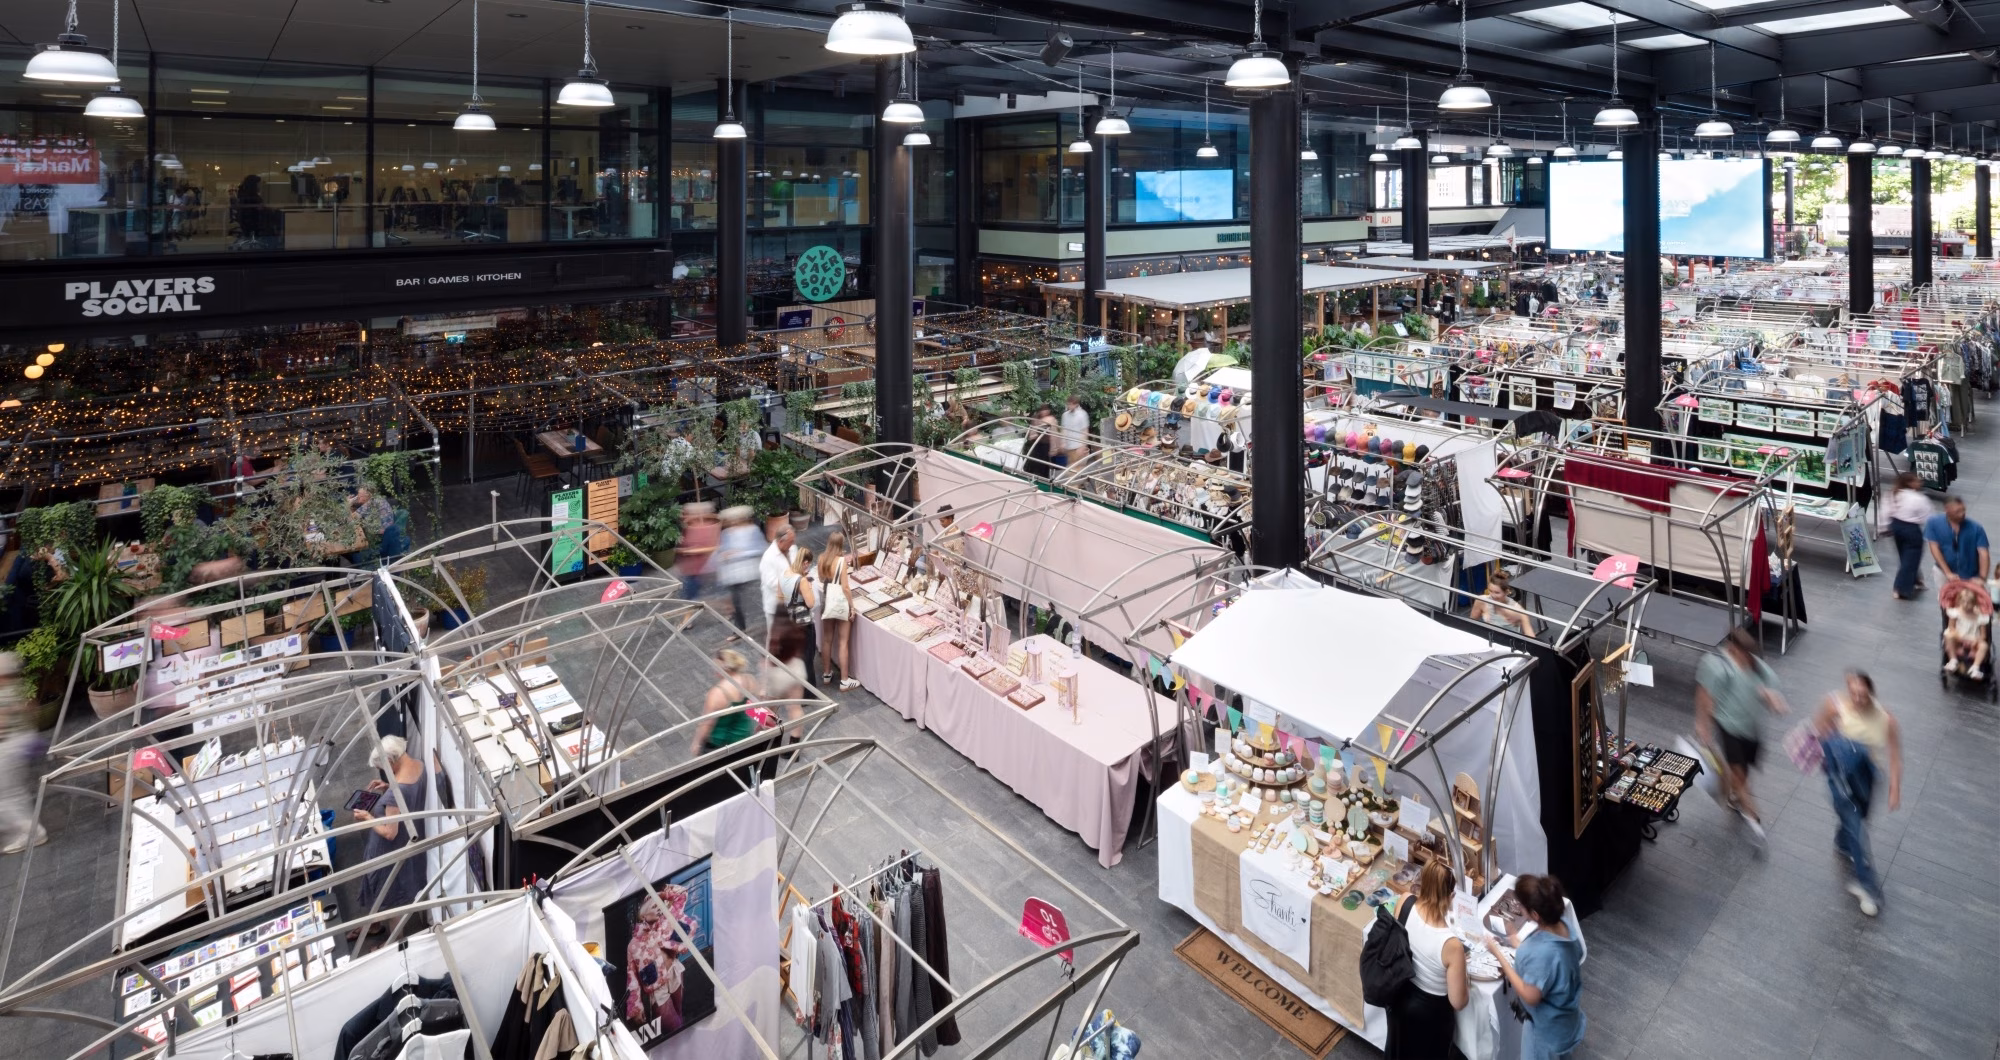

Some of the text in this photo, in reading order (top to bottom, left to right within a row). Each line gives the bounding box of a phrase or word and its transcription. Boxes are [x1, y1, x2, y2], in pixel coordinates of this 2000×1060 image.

[65, 276, 215, 301] PLAYERS
[396, 272, 522, 287] BAR GAMES KITCHEN
[82, 294, 201, 317] SOCIAL
[1040, 908, 1058, 928] 10
[1216, 950, 1309, 1021] WELCOME
